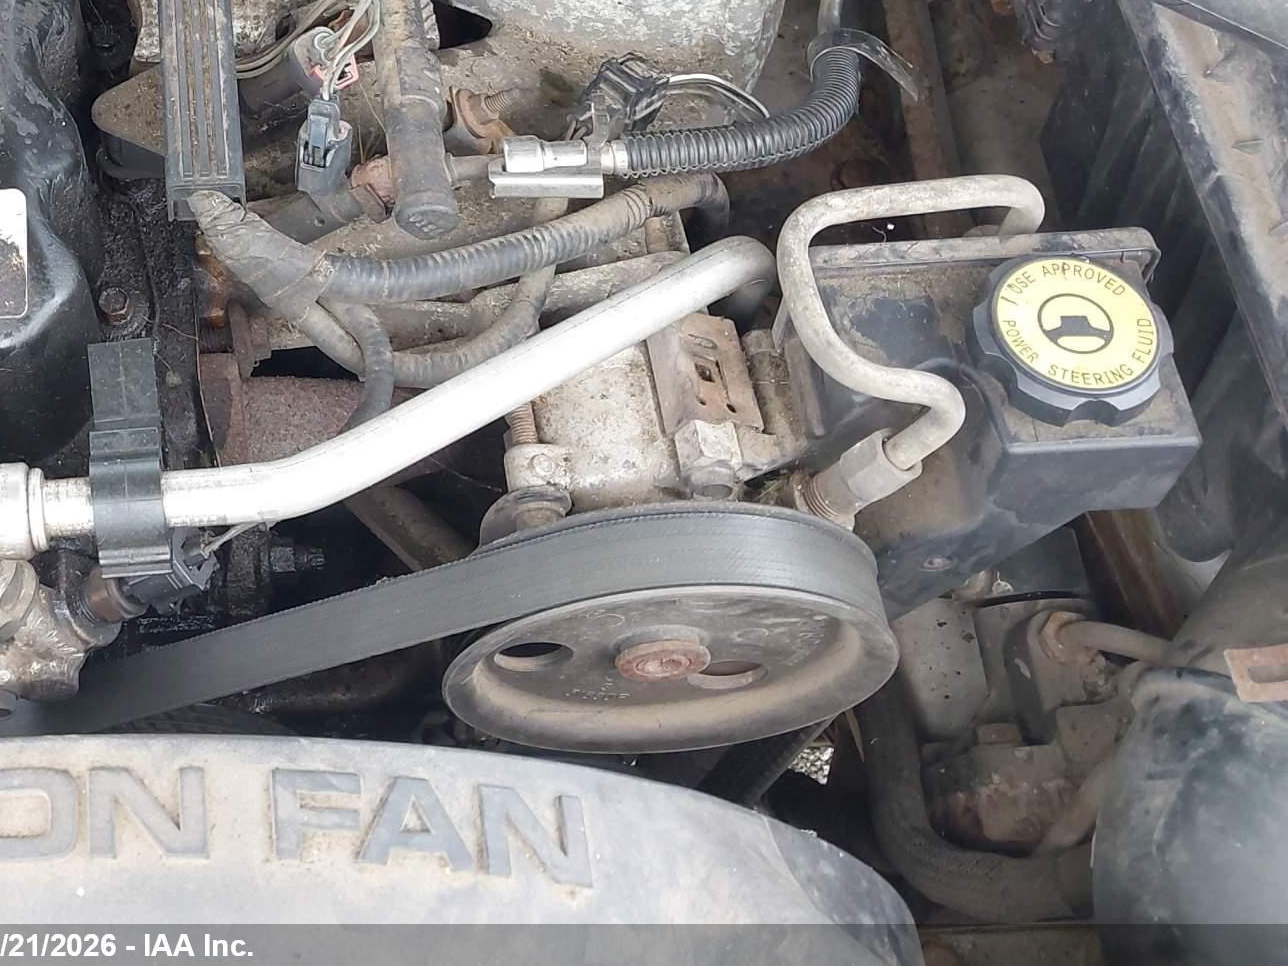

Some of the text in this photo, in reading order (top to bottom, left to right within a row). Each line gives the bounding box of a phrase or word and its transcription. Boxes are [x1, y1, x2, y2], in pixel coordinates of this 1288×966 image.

[1006, 261, 1126, 297] USE APPROVED
[1001, 318, 1155, 385] POWER STEERING FLUID
[271, 767, 594, 888] FAN
